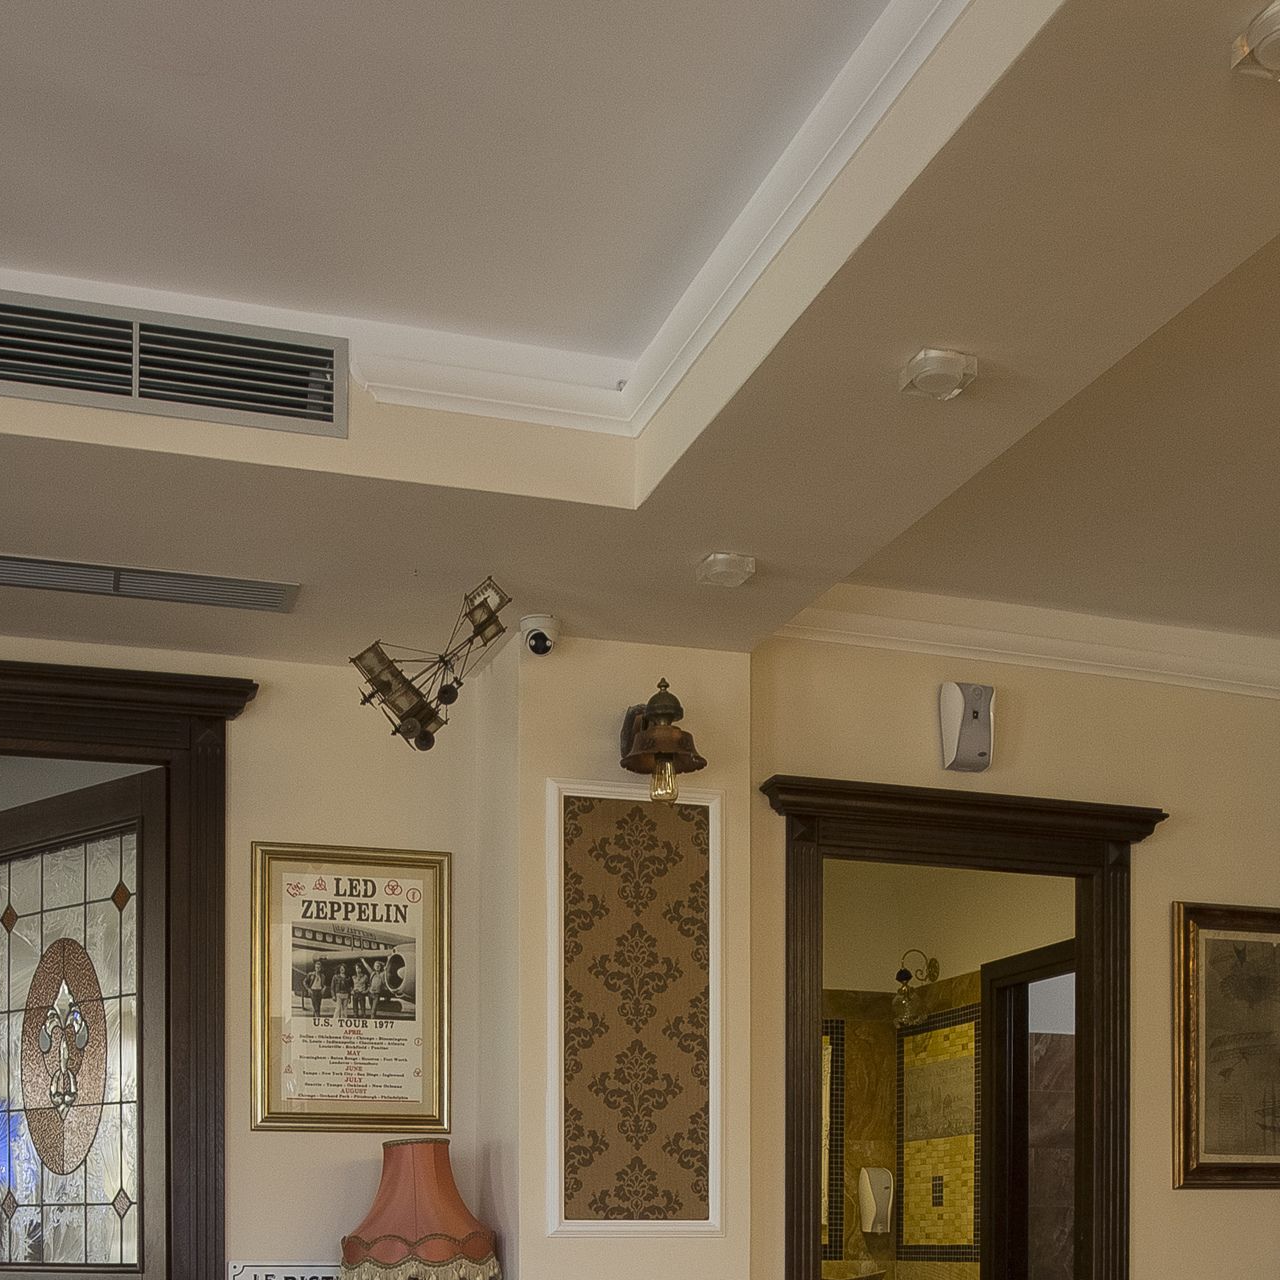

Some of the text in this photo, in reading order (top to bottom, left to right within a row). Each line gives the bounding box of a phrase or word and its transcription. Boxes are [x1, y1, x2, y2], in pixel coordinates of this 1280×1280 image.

[333, 877, 377, 898] LED
[301, 899, 408, 924] ZEPPELIN
[313, 1018, 394, 1029] U.S. TOUR 1977
